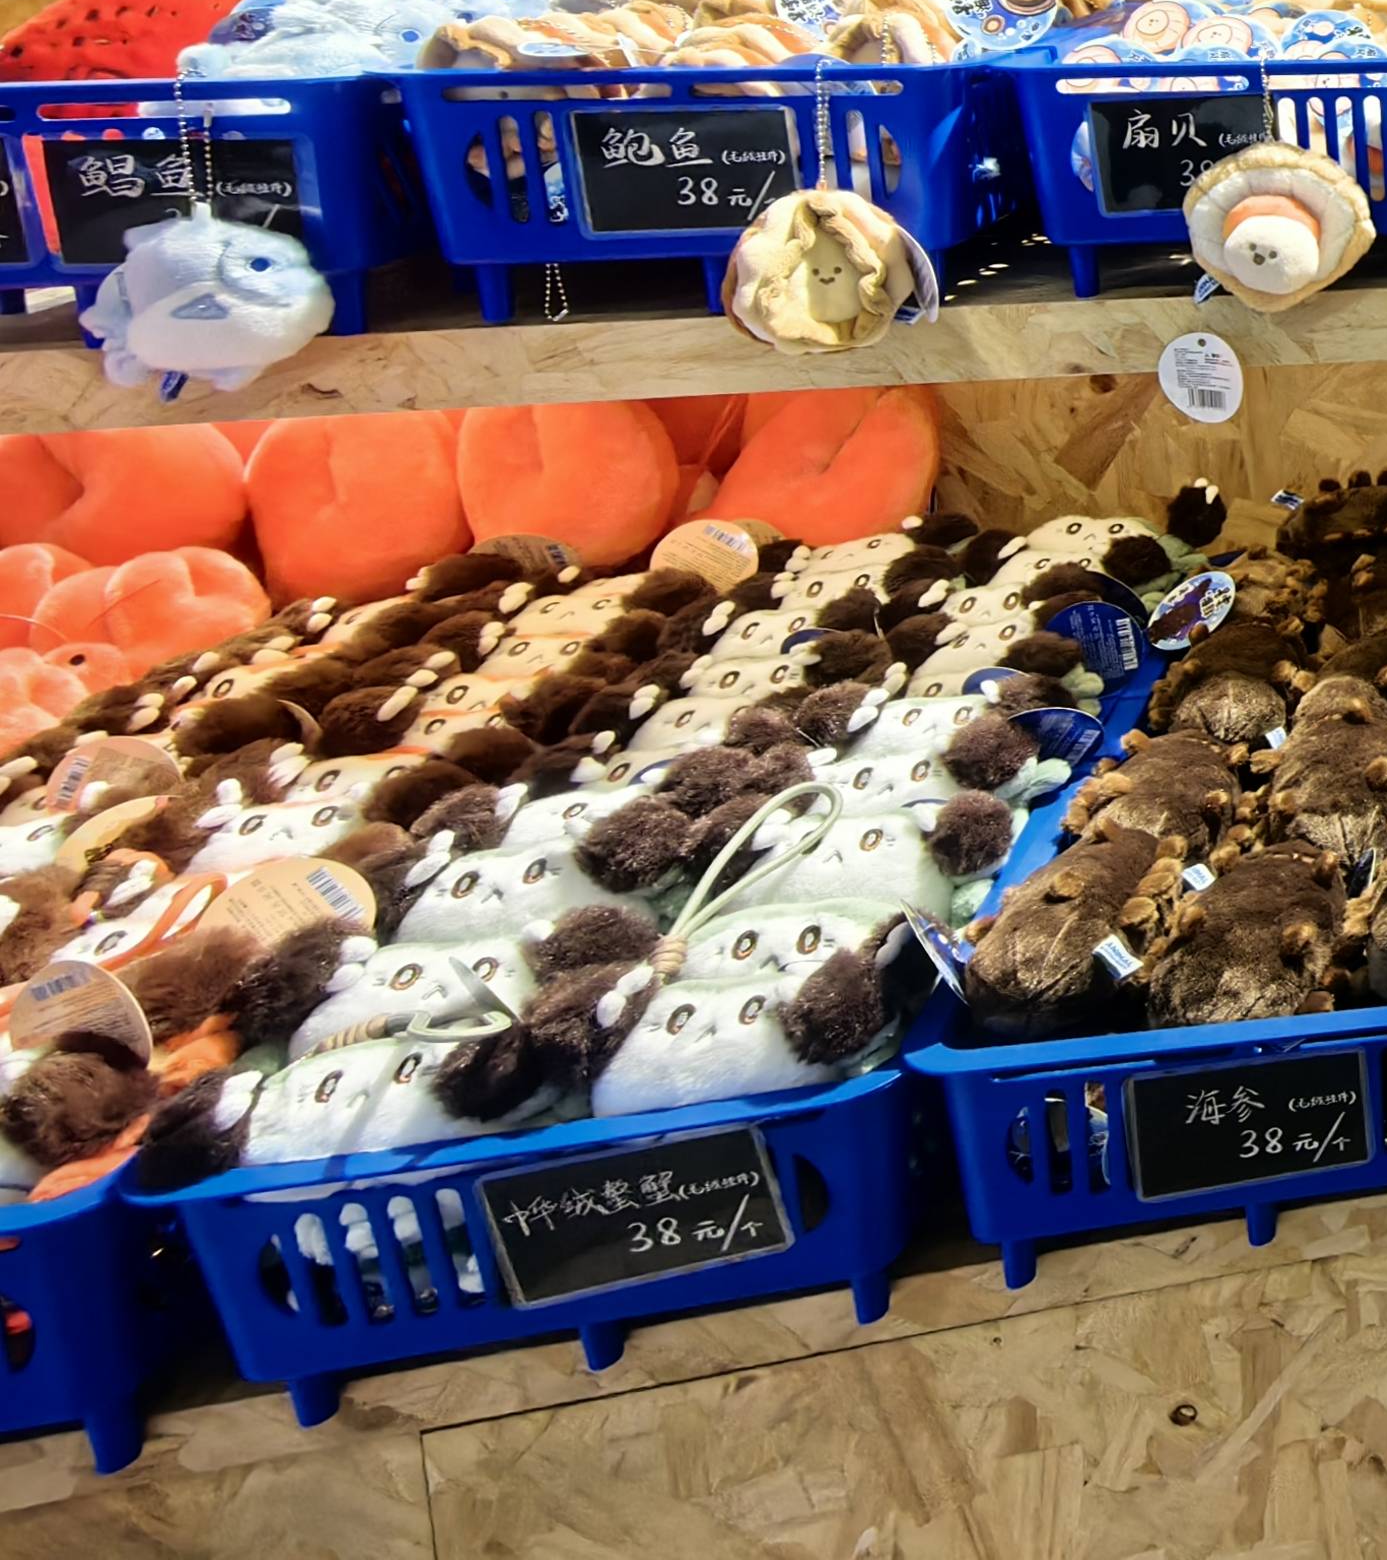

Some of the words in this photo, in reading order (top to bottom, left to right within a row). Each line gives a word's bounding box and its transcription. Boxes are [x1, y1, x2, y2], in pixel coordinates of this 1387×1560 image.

[600, 126, 714, 169] 鲍鱼
[1121, 109, 1208, 150] 扇贝
[79, 153, 206, 198] 鲳鱼
[676, 170, 776, 221] 38元/
[1184, 1085, 1266, 1125] 海参
